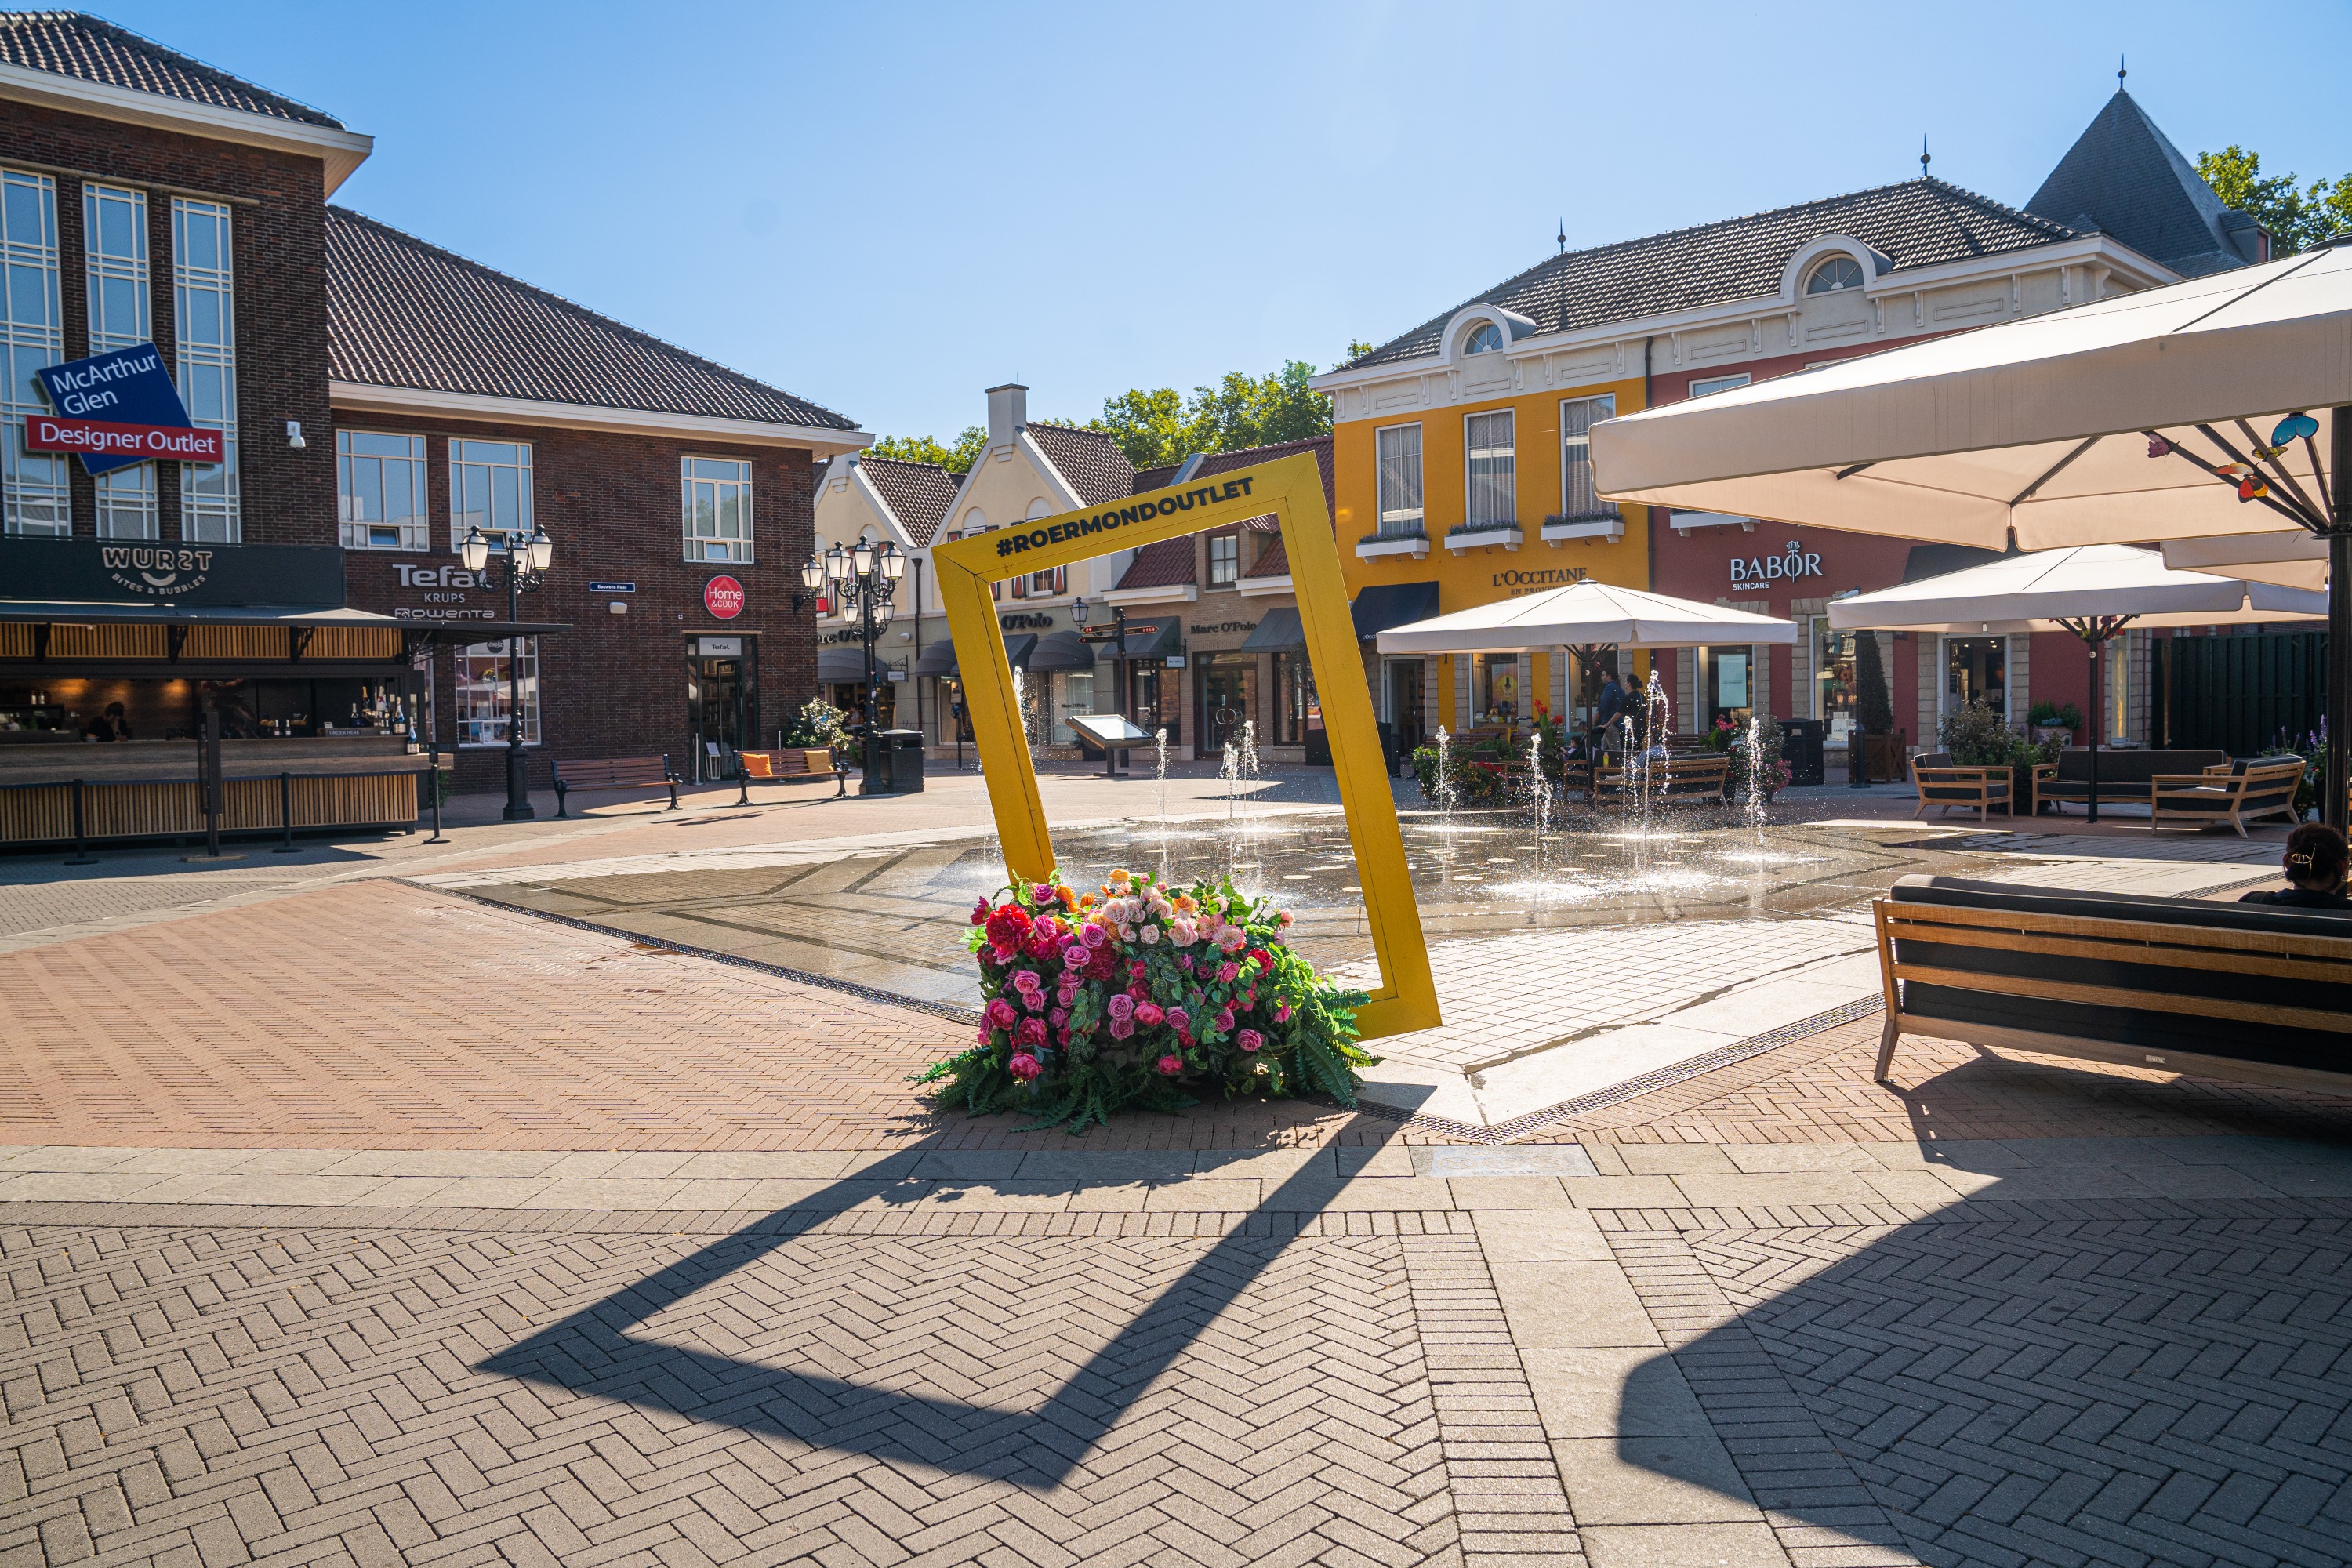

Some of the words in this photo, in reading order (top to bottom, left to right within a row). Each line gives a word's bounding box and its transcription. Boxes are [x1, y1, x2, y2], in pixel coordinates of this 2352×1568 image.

[51, 354, 158, 394] McArthur
[64, 390, 118, 415] Glen
[40, 423, 143, 451] Designer
[147, 431, 216, 453] Outlet
[996, 477, 1253, 557] #ROERMONDOUTLET
[102, 547, 212, 571] WURST
[1730, 550, 1824, 582] BABOR
[111, 573, 143, 593] BITES
[159, 575, 206, 595] BUBBLES
[708, 586, 742, 600] Home
[1525, 585, 1565, 594] PROVE
[1733, 582, 1769, 590] SKINCARE
[424, 593, 465, 603] KRUPS
[1000, 612, 1053, 630] O'Polo
[1190, 625, 1218, 633] Marc
[1221, 622, 1258, 632] O'Polo
